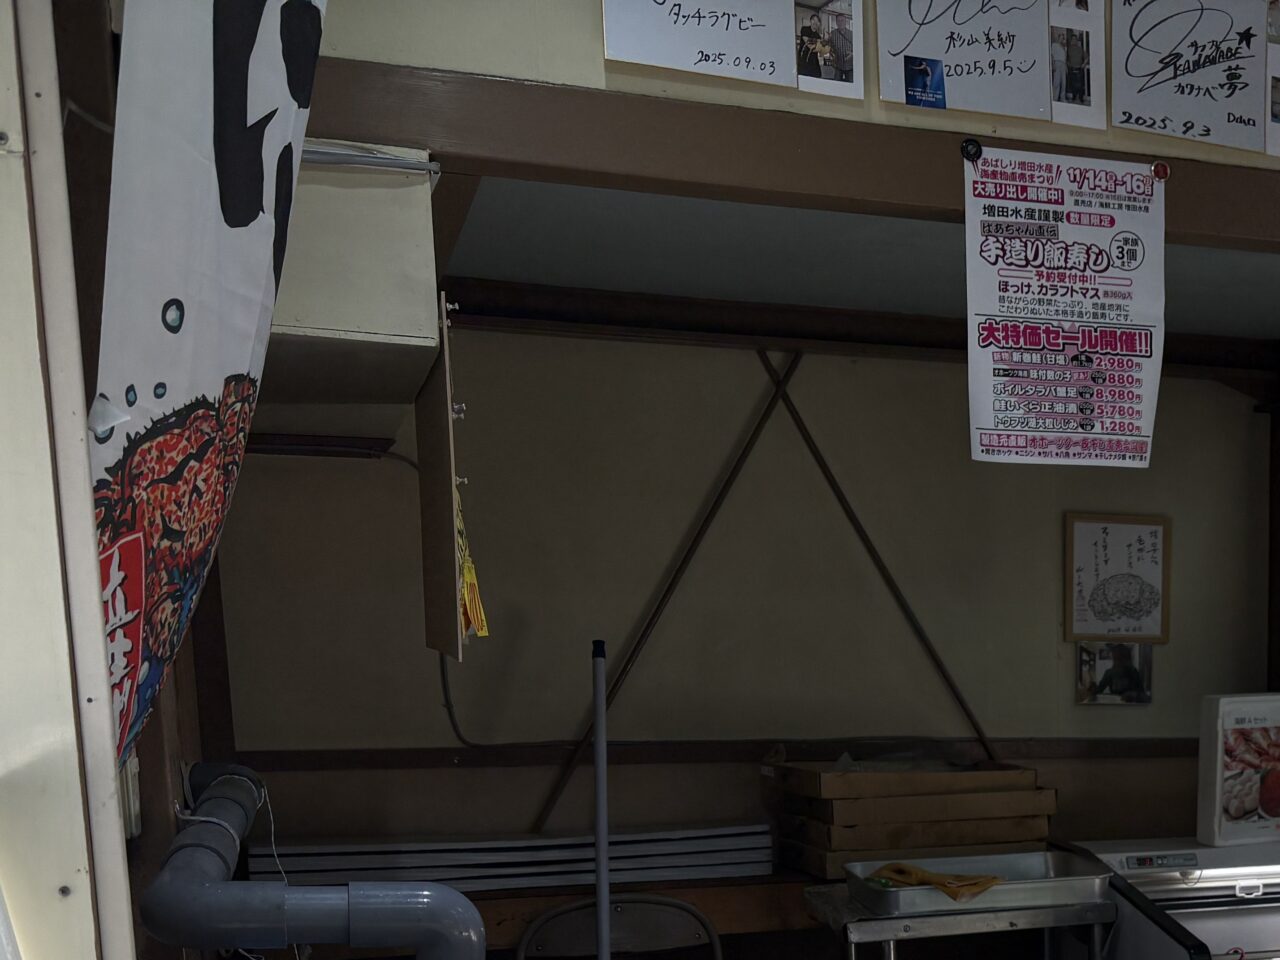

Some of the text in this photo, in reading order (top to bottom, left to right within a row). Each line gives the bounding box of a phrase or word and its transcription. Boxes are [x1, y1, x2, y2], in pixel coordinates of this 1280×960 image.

[693, 50, 777, 76] 2025.09.03
[981, 157, 1054, 173] あばしり増田水産
[982, 204, 1112, 228] 増田水産謹製 数量限定
[979, 235, 1111, 273] 手造り飯寿し
[1115, 245, 1138, 262] 3個
[998, 280, 1101, 300] ほっけ、カラフトマス
[1094, 357, 1143, 371] 2,980円
[1107, 375, 1143, 388] 880円
[1095, 389, 1143, 402] 8,980円
[1096, 405, 1143, 418] 5,780円
[1099, 421, 1143, 434] 1,280円
